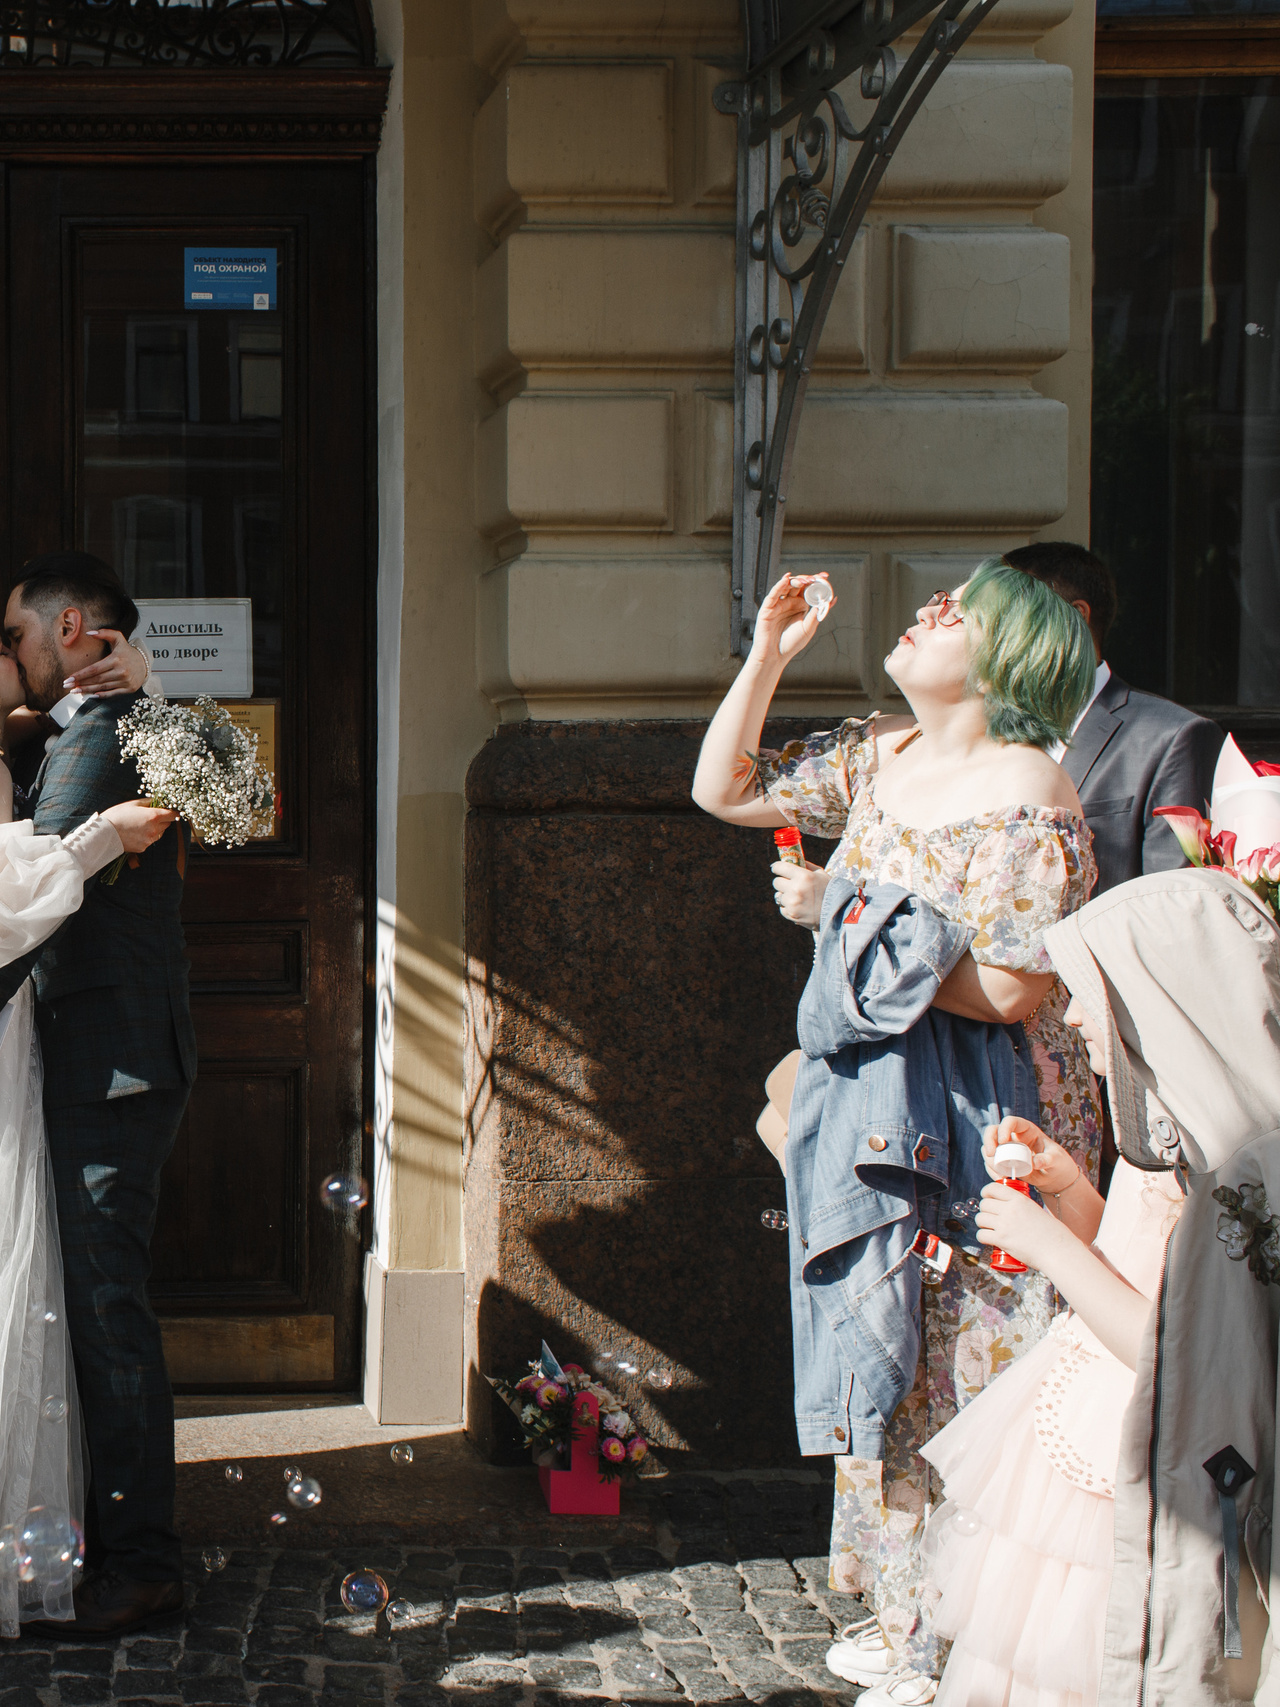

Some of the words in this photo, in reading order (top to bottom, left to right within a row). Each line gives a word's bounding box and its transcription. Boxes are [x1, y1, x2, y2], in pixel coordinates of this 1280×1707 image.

[194, 265, 216, 273] ПОД
[218, 263, 267, 273] ОХРАНОЙ
[146, 622, 223, 634] Апостиль
[152, 649, 169, 659] во
[173, 648, 219, 661] дворе
